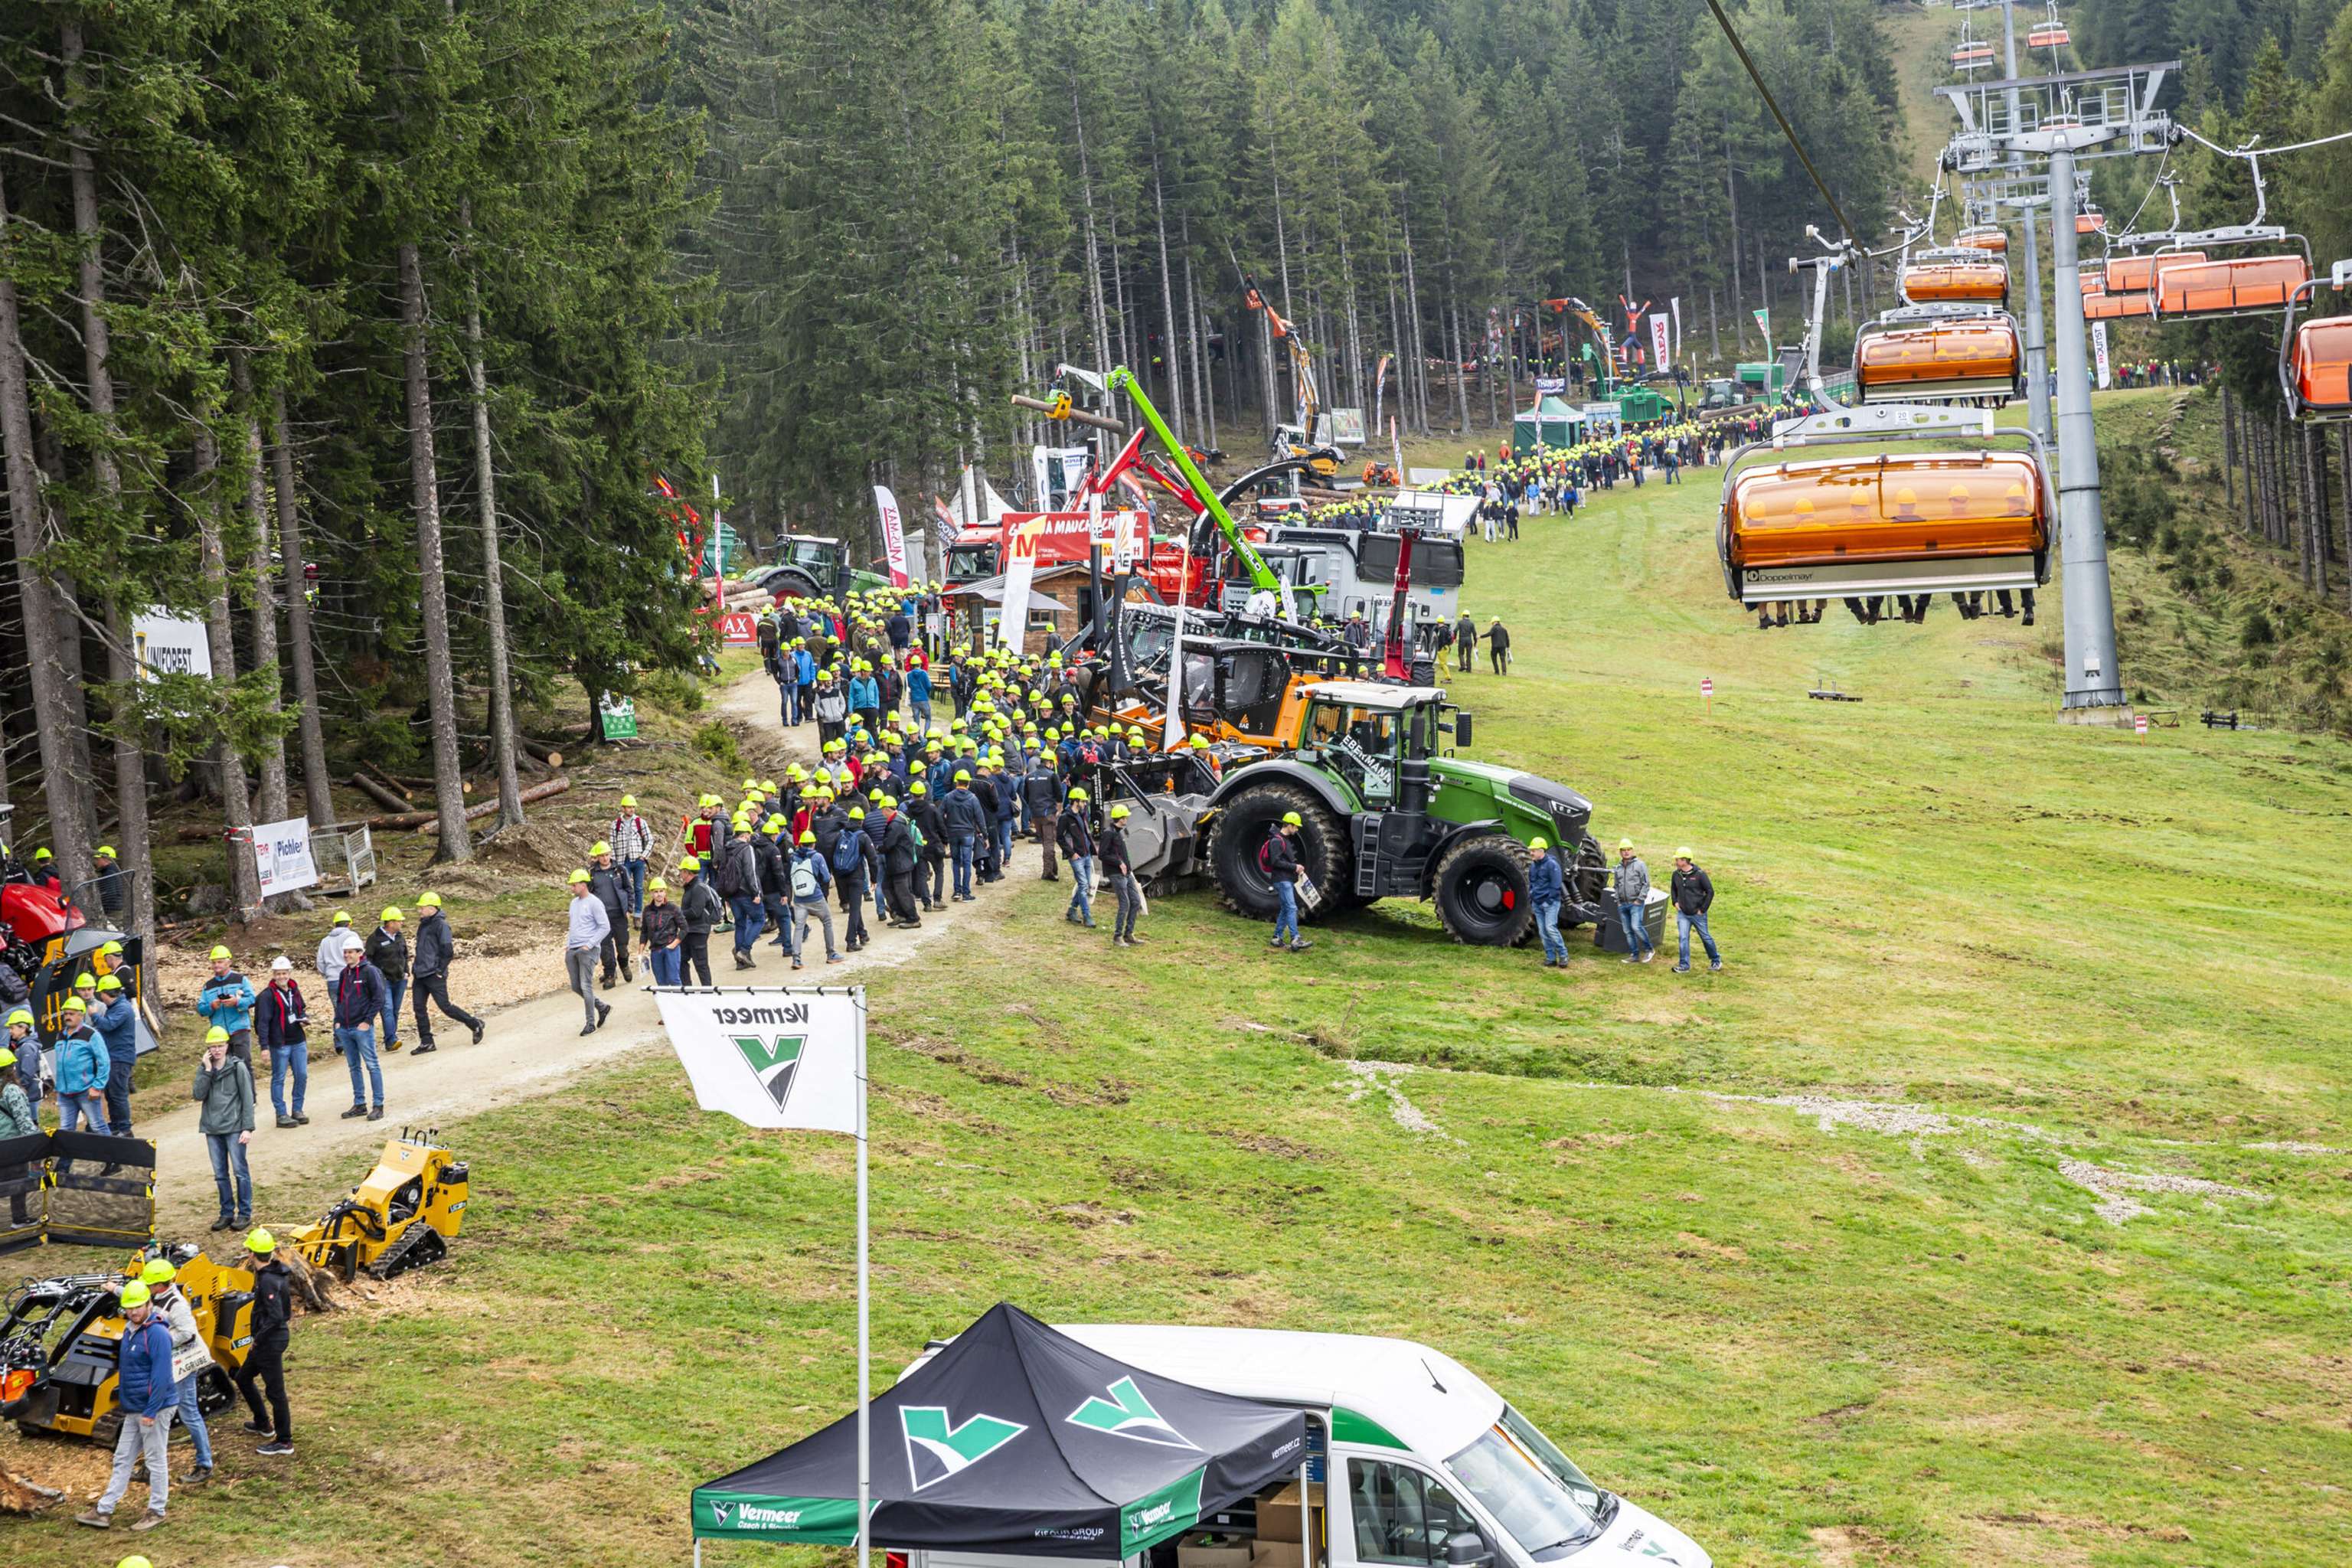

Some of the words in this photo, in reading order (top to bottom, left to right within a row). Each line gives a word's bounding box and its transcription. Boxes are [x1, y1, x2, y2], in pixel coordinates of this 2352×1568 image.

[1236, 537, 1263, 572] MERLO
[1760, 573, 1812, 582] Doppelmayr
[146, 647, 192, 675] UNIFOREST
[1341, 734, 1392, 784] EBERMANN
[1271, 1437, 1300, 1459] vermeer.cz
[739, 1502, 803, 1524] Vermeer
[1142, 1501, 1172, 1524] Vermeer
[737, 1521, 760, 1530] Czech
[1071, 1527, 1104, 1537] GROUP
